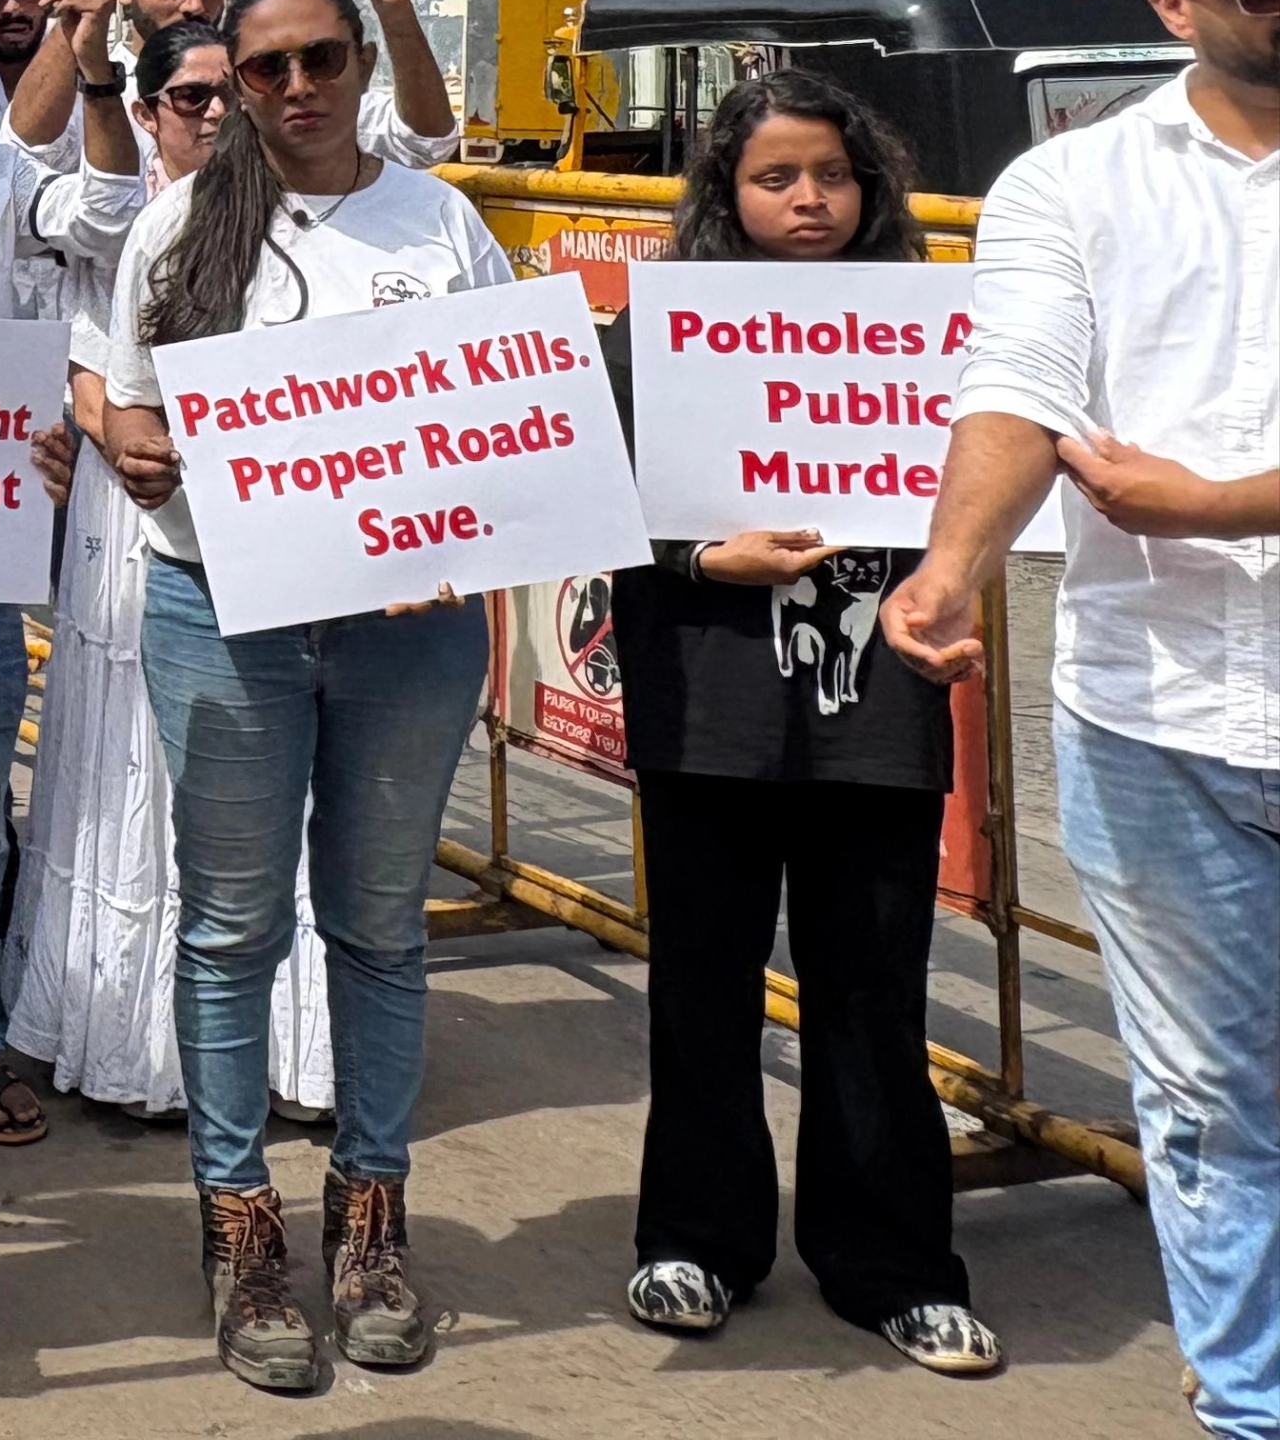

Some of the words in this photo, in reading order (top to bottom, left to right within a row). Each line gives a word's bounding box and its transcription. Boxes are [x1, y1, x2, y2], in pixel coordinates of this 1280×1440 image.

[561, 229, 672, 262] MANGALUR
[667, 311, 925, 355] Potholes
[175, 351, 456, 437] Patchwork
[458, 331, 590, 386] Kills.
[763, 381, 951, 427] Public
[227, 441, 406, 502] Proper
[415, 405, 574, 469] Roads
[738, 449, 940, 497] Murde
[358, 506, 493, 556] Save.
